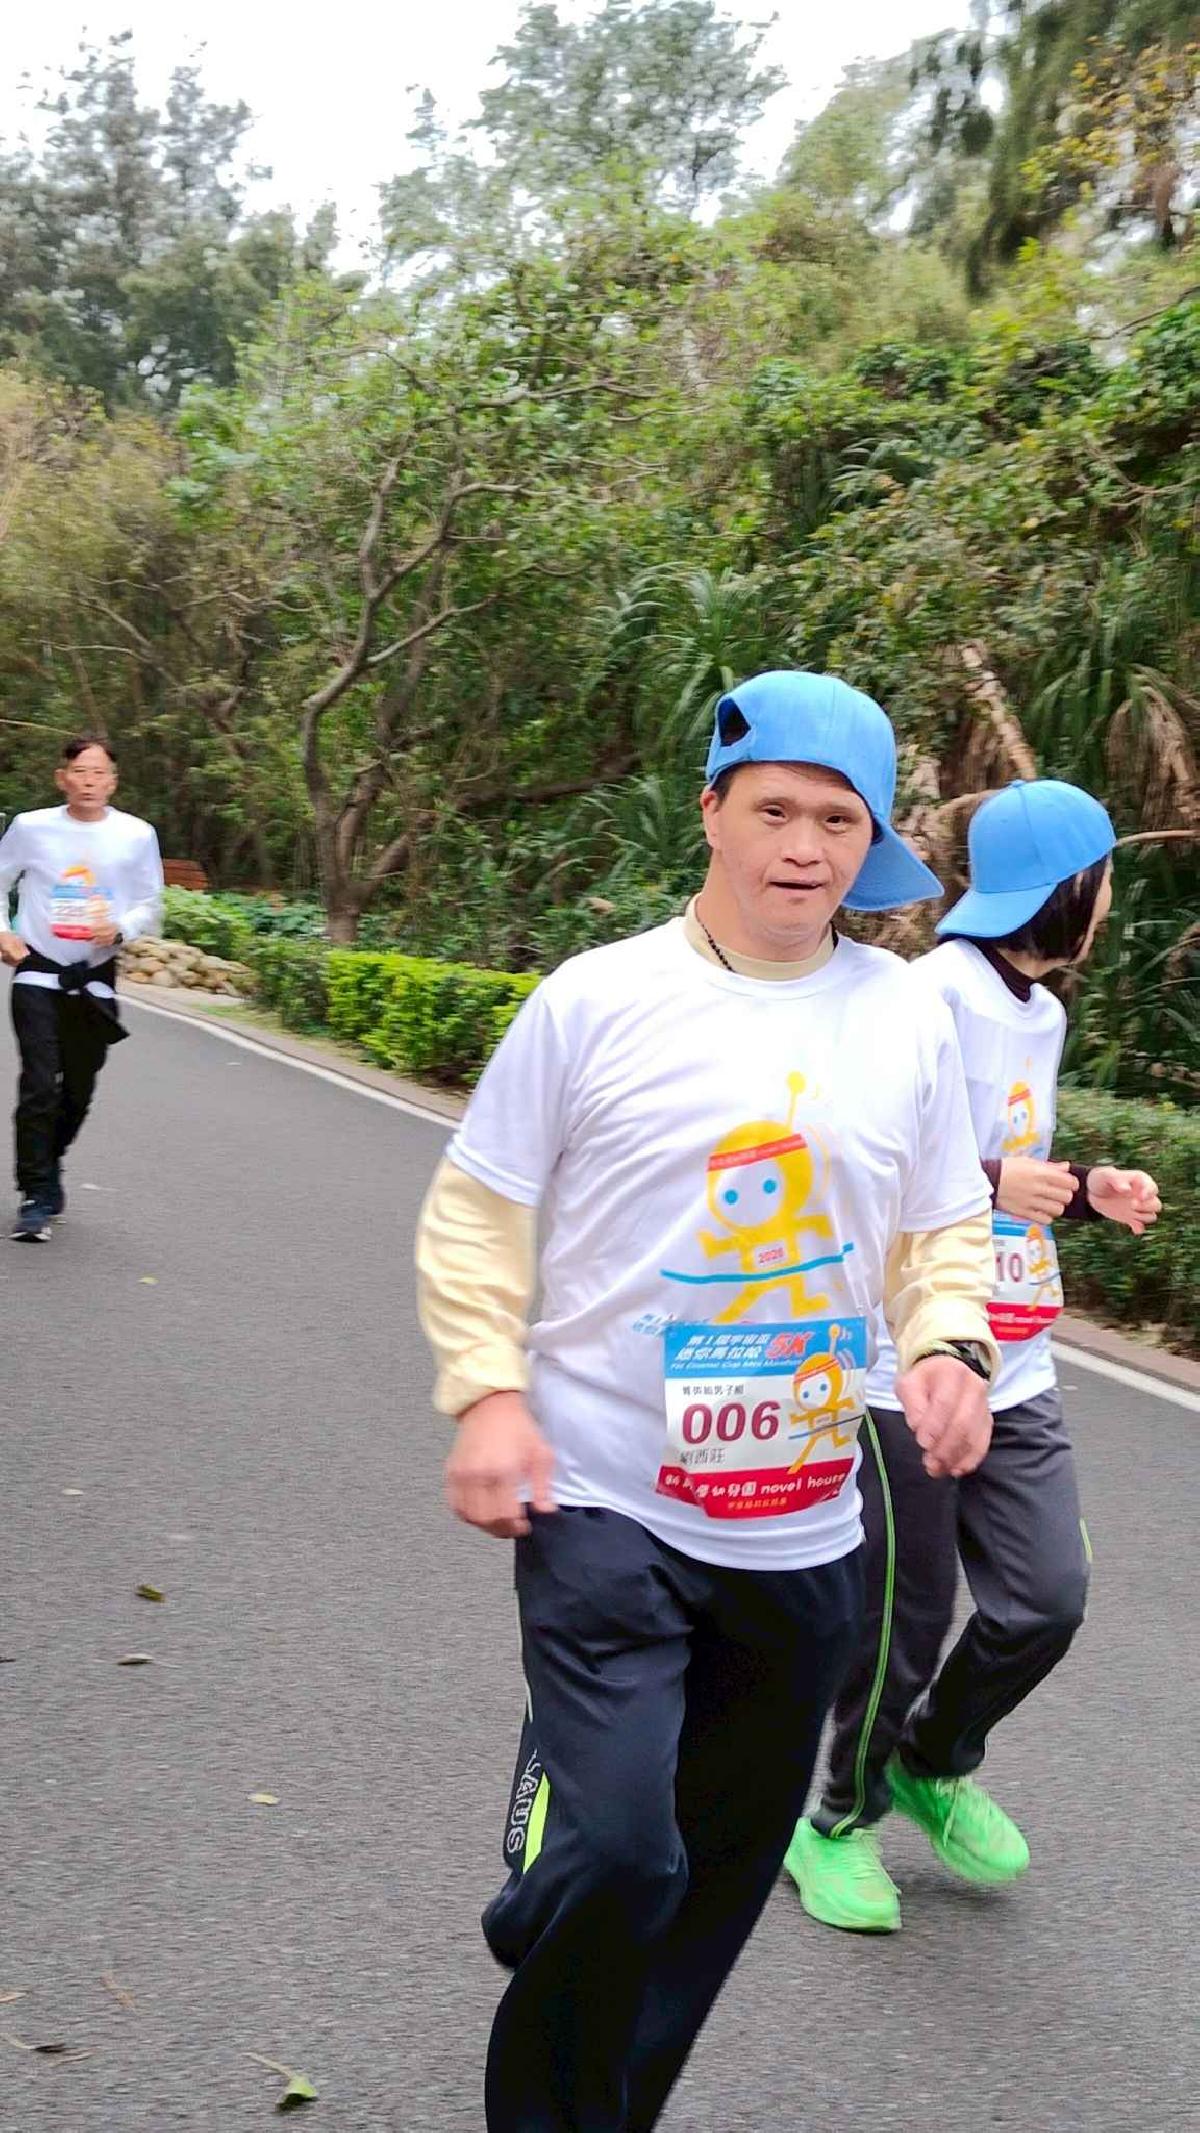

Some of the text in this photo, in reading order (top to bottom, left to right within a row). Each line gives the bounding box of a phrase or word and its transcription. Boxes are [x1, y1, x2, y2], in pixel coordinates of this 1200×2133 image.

[765, 1331, 813, 1359] 5K
[682, 1400, 781, 1444] 006
[760, 1477, 802, 1495] novel
